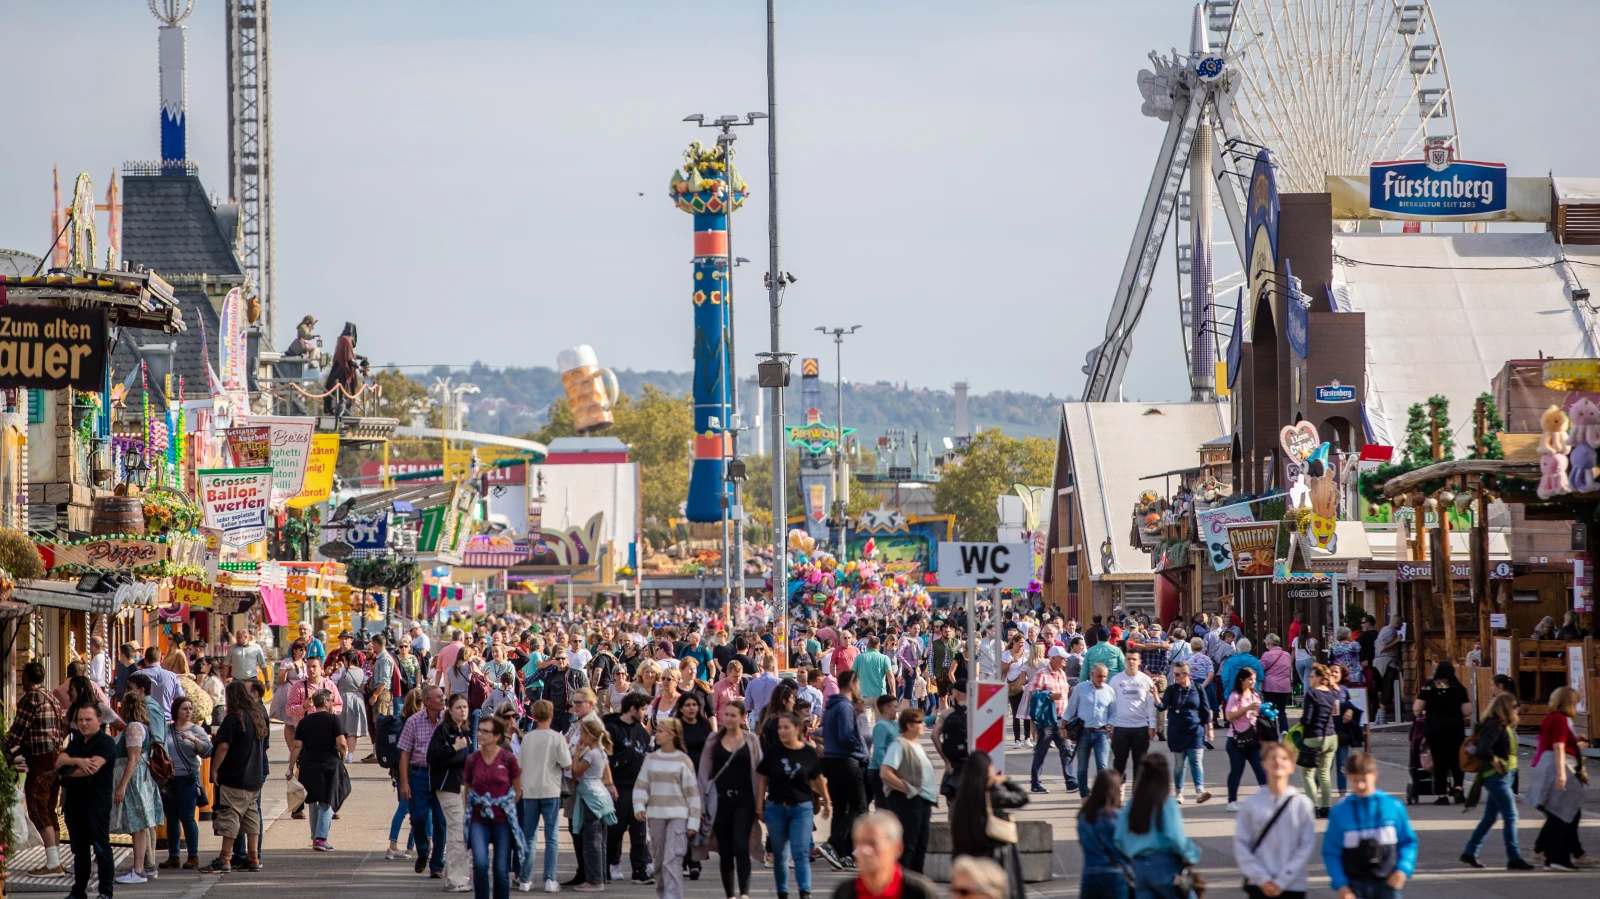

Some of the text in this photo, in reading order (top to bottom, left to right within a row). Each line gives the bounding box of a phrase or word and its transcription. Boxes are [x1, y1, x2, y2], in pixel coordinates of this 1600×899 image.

[1383, 170, 1493, 205] Fürstenberg
[0, 316, 91, 340] Zum alten
[0, 340, 92, 379] auer
[1320, 389, 1352, 398] Fürstenberg
[1290, 433, 1309, 444] I Love
[270, 447, 301, 458] aghetti
[270, 458, 299, 468] tellini
[273, 470, 297, 478] atoni
[212, 476, 258, 488] Grosses
[206, 487, 262, 502] Ballon-
[213, 497, 265, 513] werfen
[1229, 528, 1276, 551] Churros
[85, 541, 157, 568] Pizza
[960, 545, 1010, 574] WC
[1402, 564, 1432, 576] Servi
